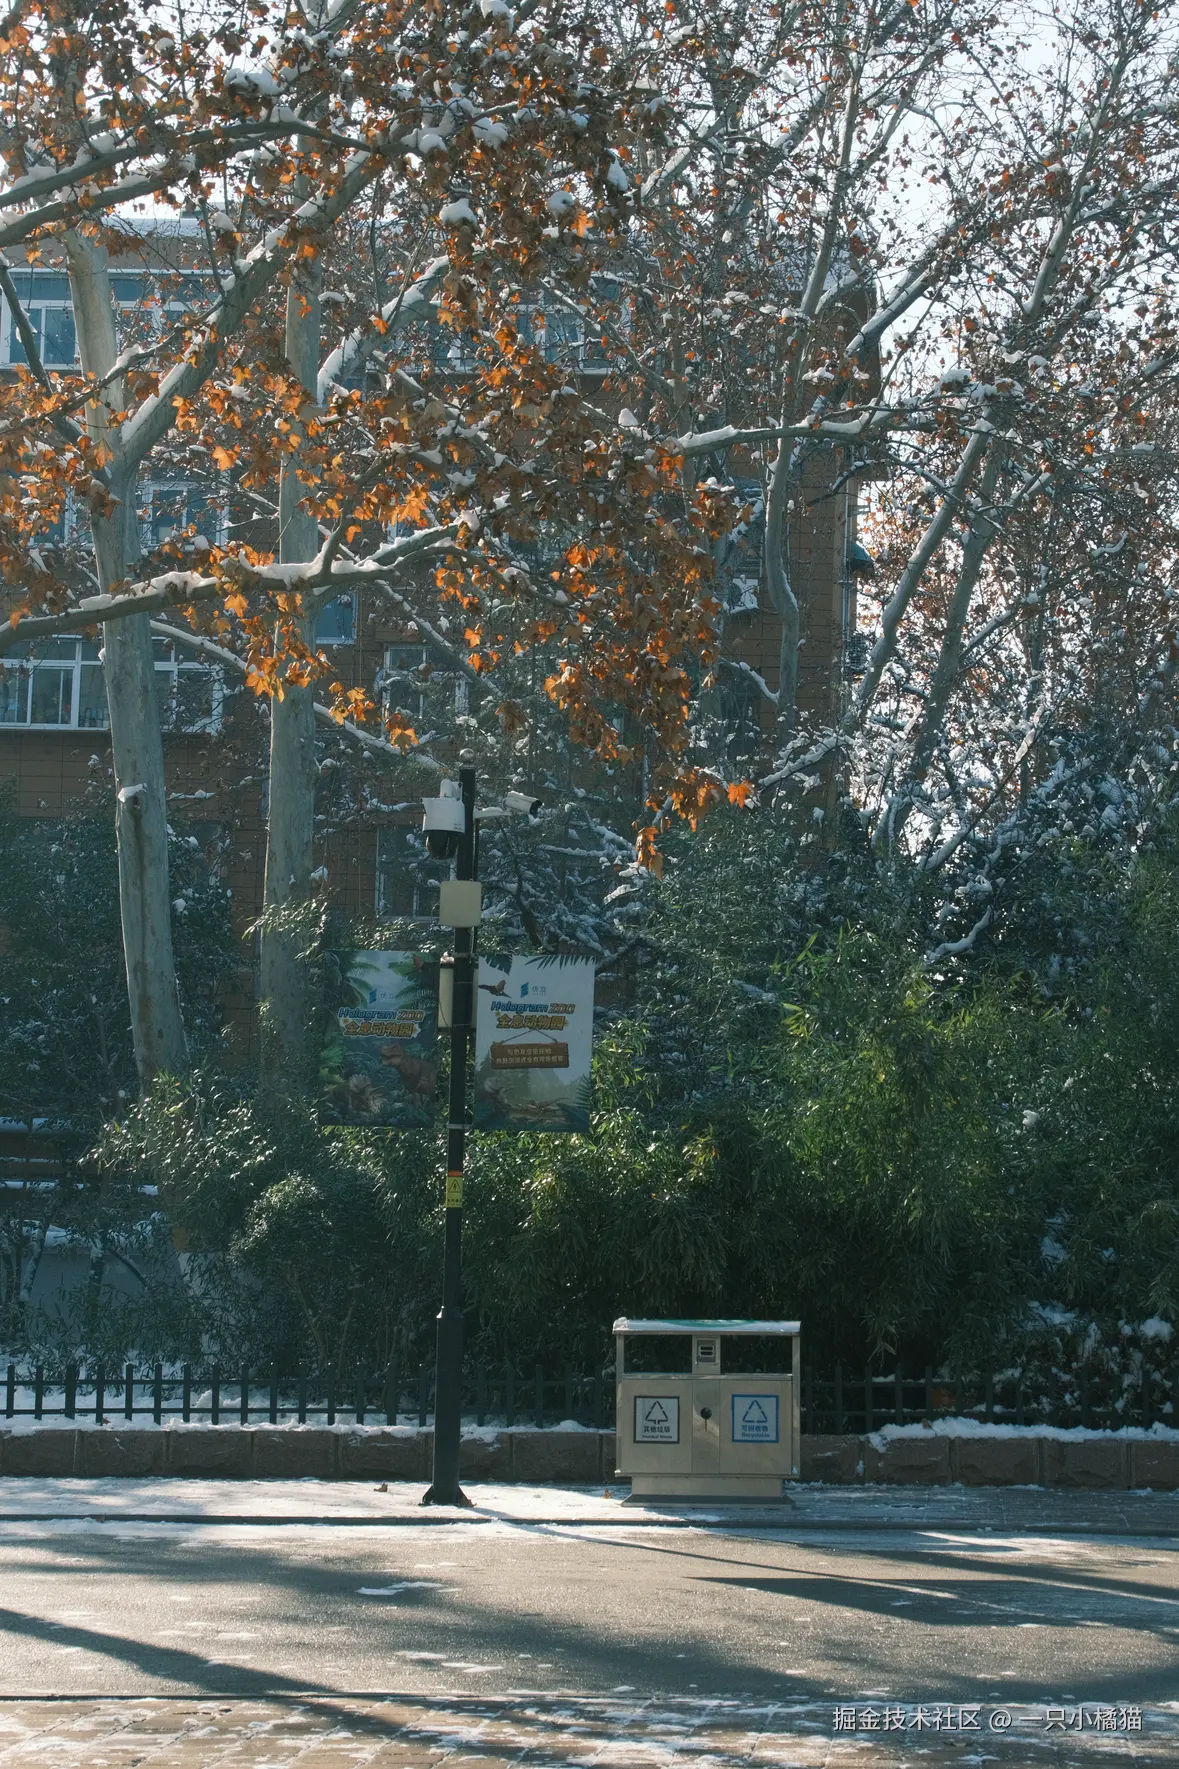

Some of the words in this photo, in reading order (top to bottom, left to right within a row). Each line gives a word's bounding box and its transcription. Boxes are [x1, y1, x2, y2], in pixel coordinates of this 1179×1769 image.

[339, 1007, 396, 1021] Hologram
[491, 1001, 548, 1014] Hologram
[496, 1014, 565, 1030] 全息动物园
[344, 1021, 414, 1037] 全息动物园
[644, 1425, 671, 1433] 其他垃圾
[741, 1424, 768, 1432] 可回收物
